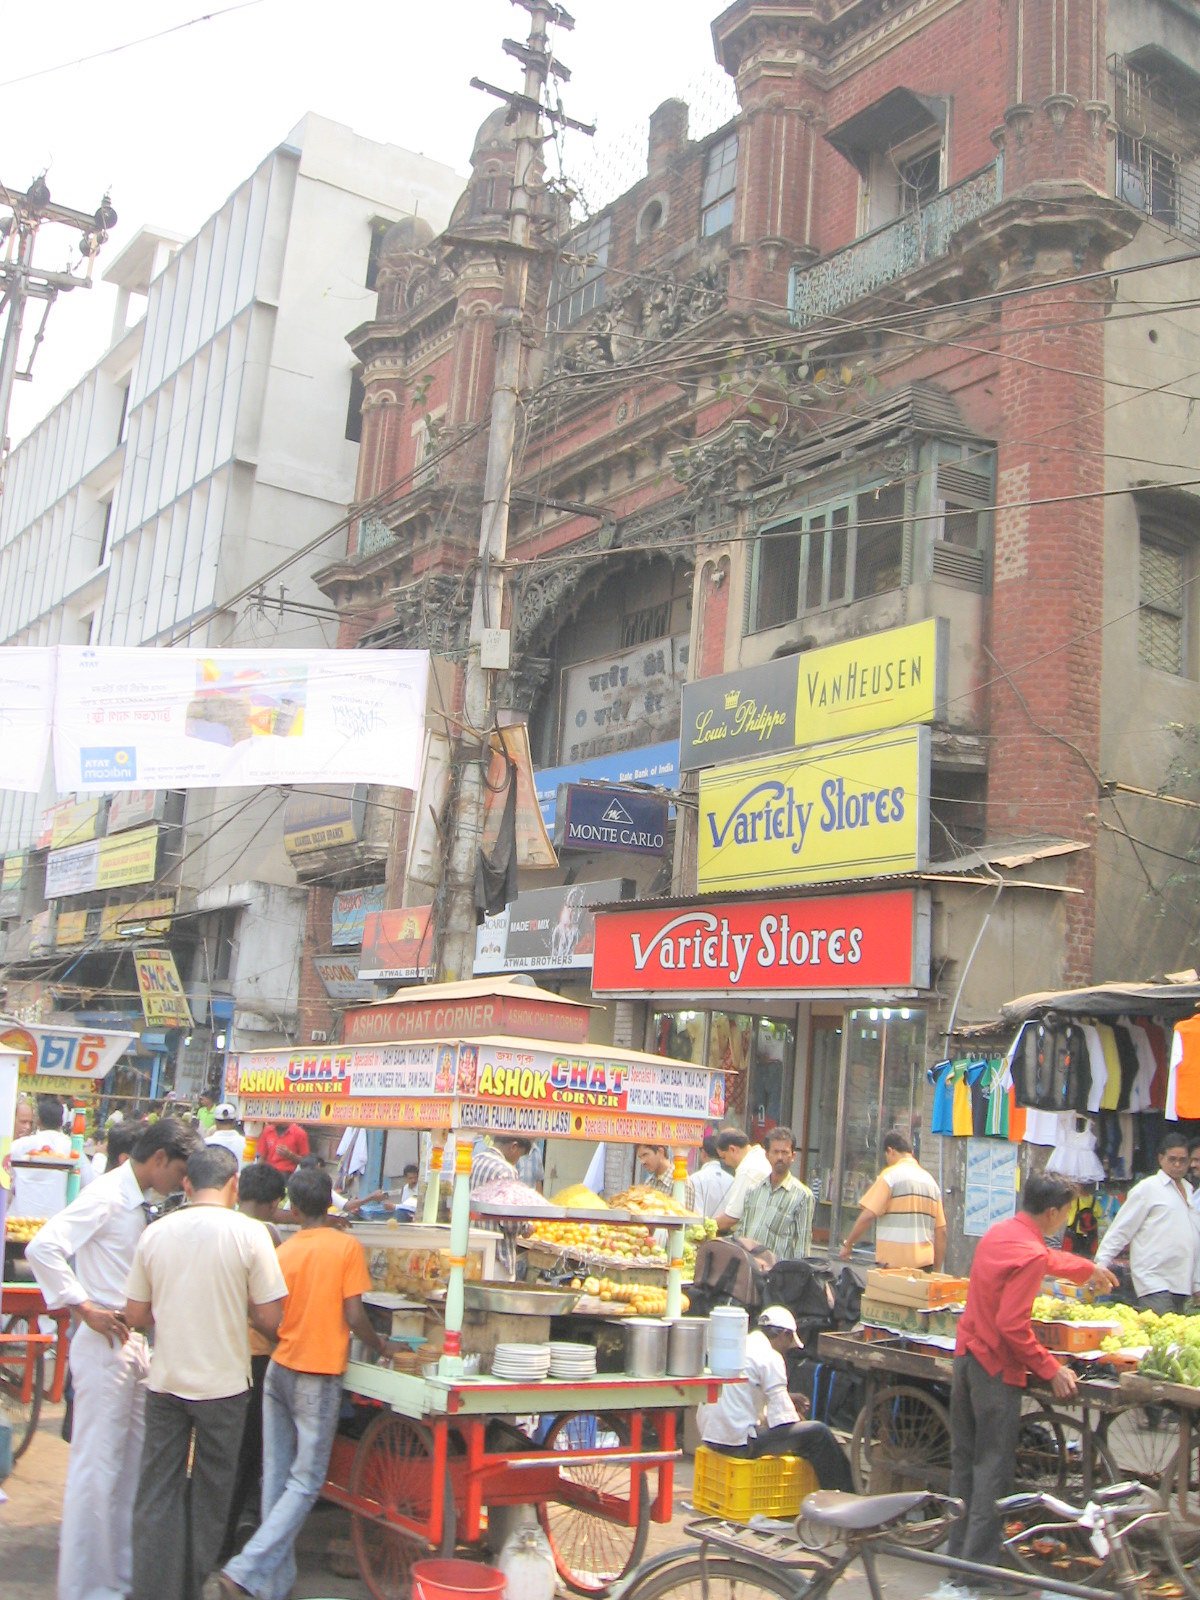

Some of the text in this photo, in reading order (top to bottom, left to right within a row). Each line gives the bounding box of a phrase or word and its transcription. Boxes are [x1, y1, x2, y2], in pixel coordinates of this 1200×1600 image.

[692, 710, 727, 745] Louis
[731, 699, 787, 741] Philippe
[634, 768, 649, 779] Bank
[651, 766, 657, 775] of
[659, 763, 674, 774] India
[707, 777, 905, 854] Variety Stores
[569, 823, 664, 848] MONTE CARLO
[631, 911, 864, 984] Variety Stores
[379, 970, 404, 978] ATWAL
[503, 955, 573, 968] ATWAL BROTHERS
[352, 1004, 494, 1038] ASHOK CHAT CORNER
[508, 1009, 584, 1032] ASHOK CHAT CORNER
[40, 1034, 107, 1072] চাট
[287, 1051, 352, 1081] CHAT
[495, 1051, 535, 1066] জয় গুরু
[240, 1067, 287, 1093] ASHOK
[288, 1082, 343, 1093] CORNER
[478, 1062, 550, 1099] ASHOK
[550, 1056, 629, 1094] CHAT
[551, 1089, 619, 1107] CORNER
[460, 1105, 571, 1134] KESARIA FALUDA COOLFI & LASSI
[616, 1117, 634, 1137] ORDER
